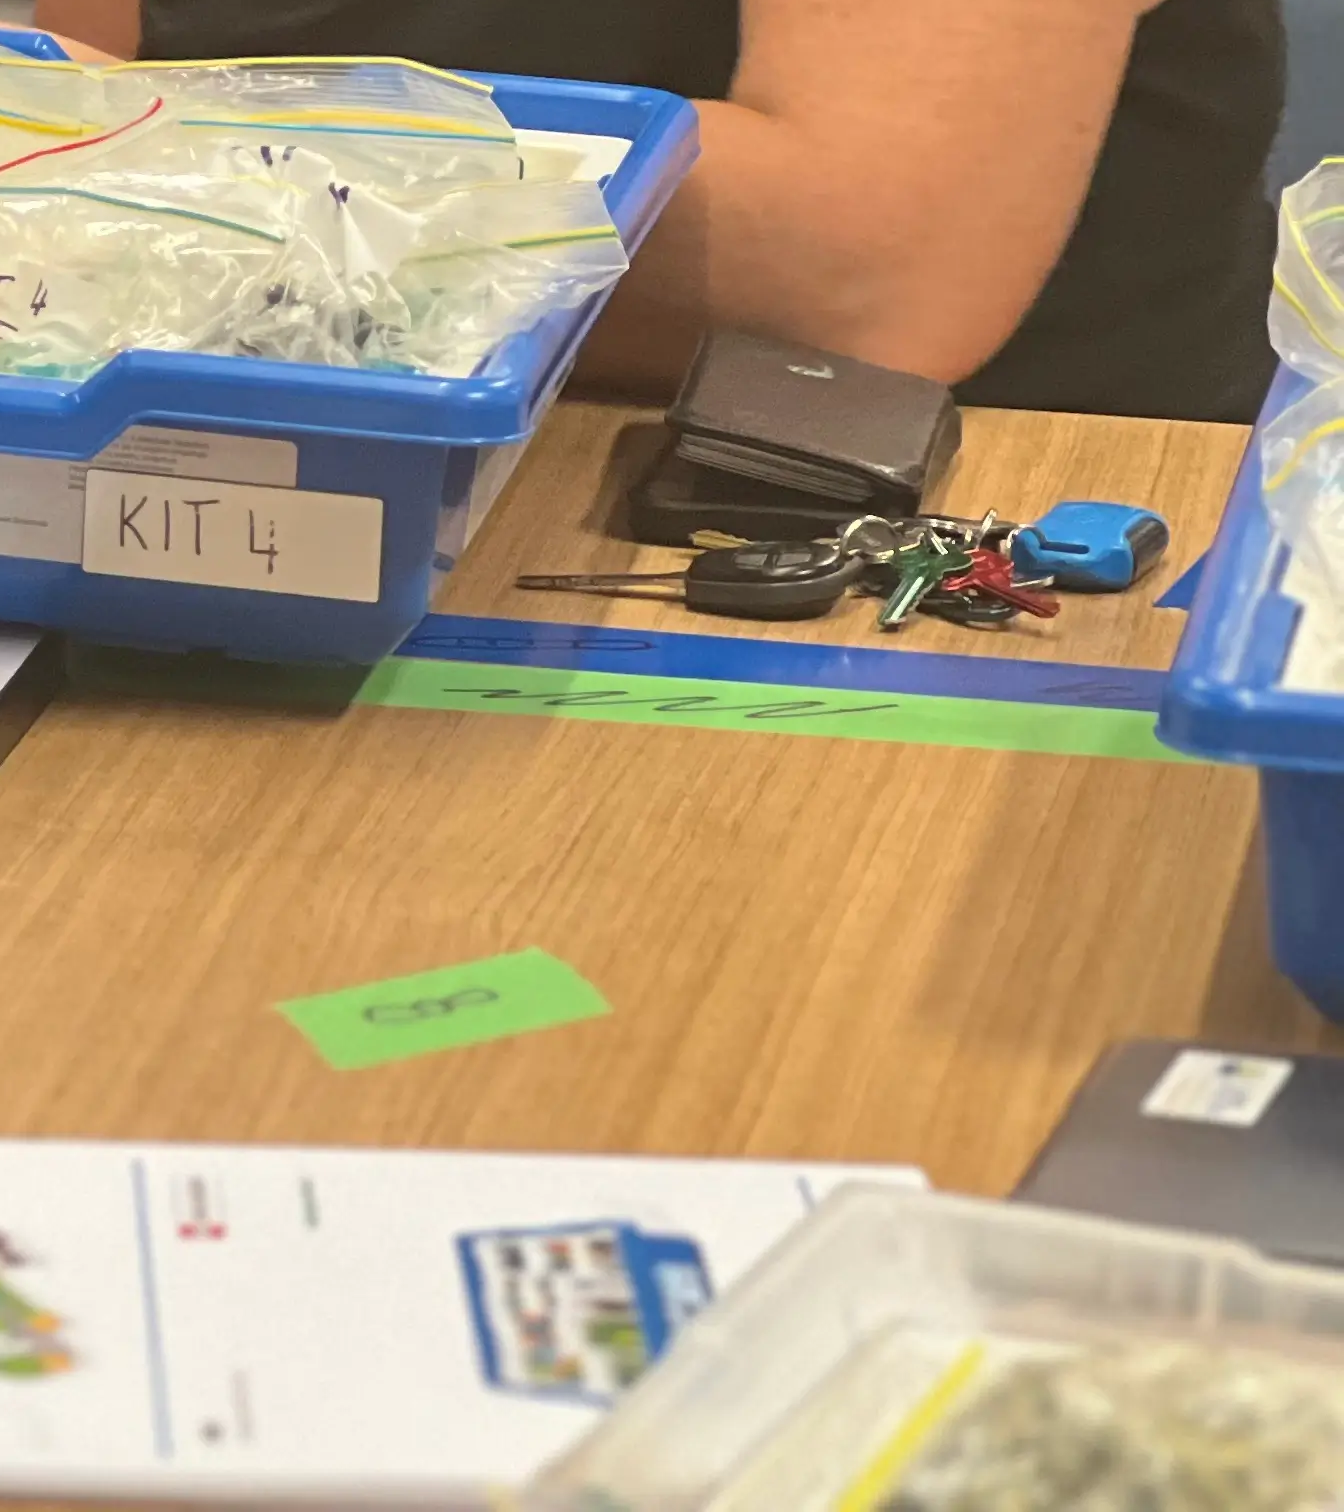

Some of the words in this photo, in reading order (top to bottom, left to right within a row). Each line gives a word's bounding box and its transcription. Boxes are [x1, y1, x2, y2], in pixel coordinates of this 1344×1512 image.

[29, 278, 49, 317] 4
[117, 492, 221, 556] KIT
[248, 508, 280, 576] 4
